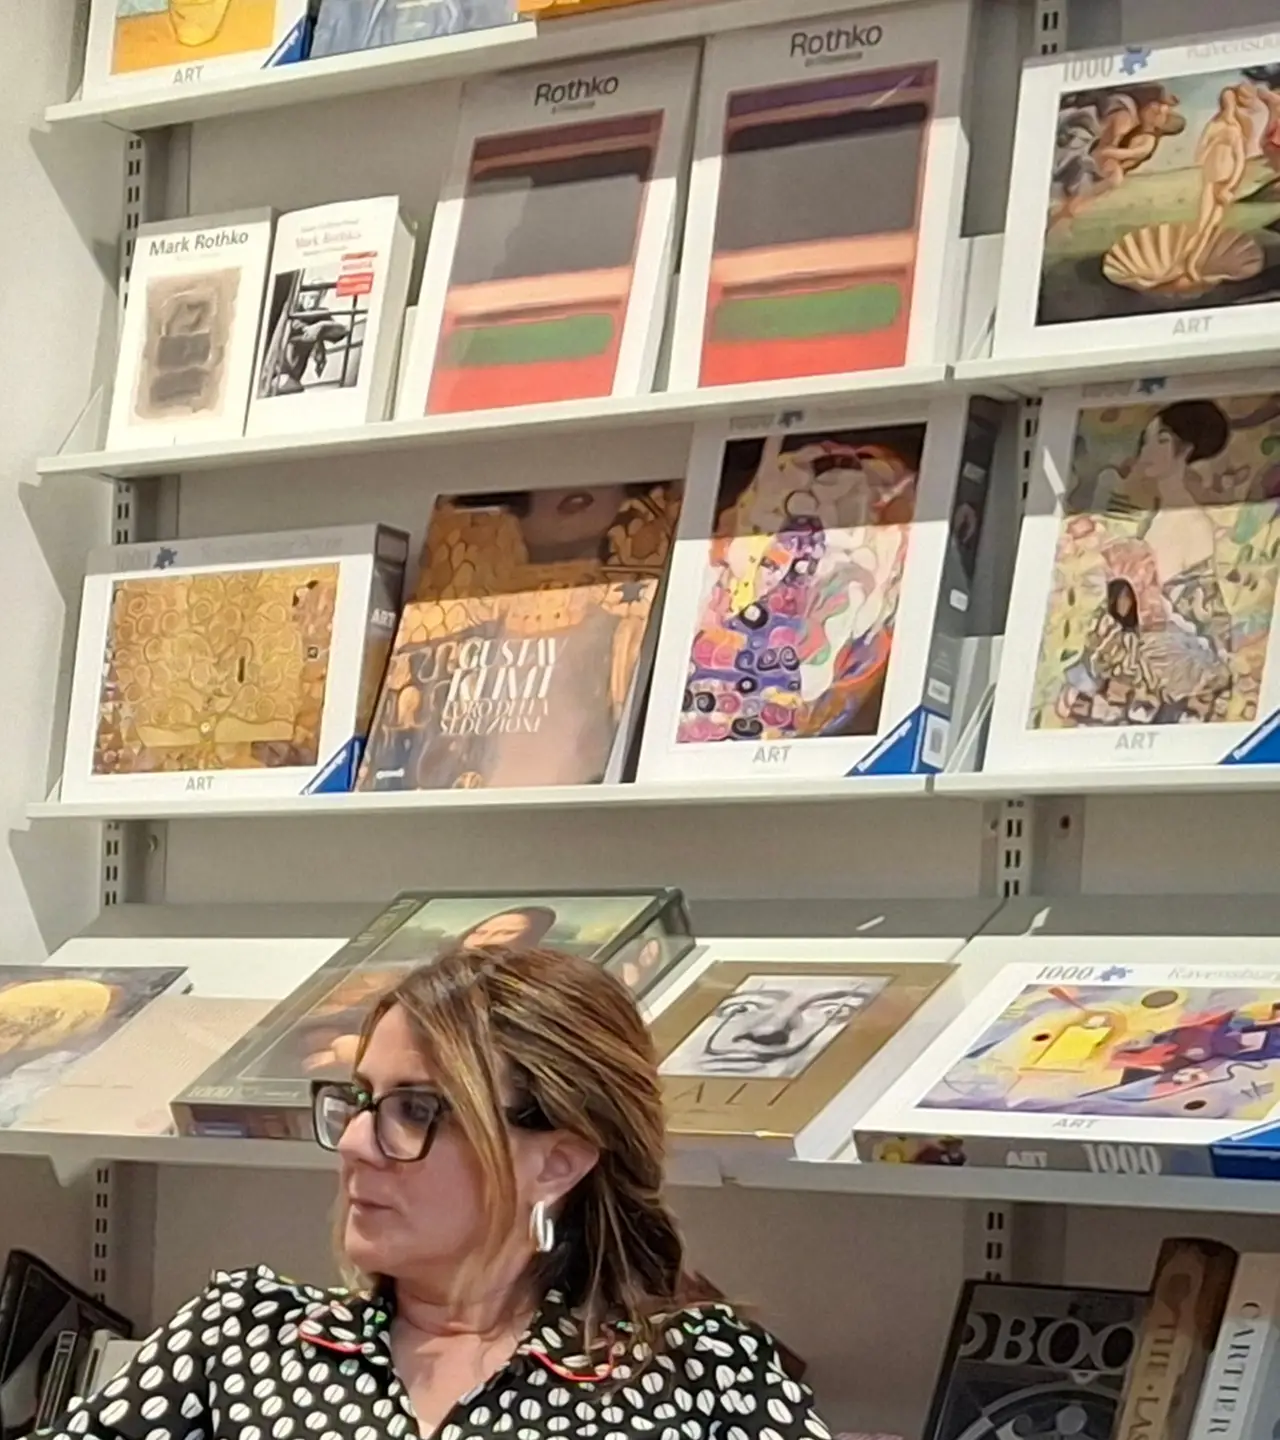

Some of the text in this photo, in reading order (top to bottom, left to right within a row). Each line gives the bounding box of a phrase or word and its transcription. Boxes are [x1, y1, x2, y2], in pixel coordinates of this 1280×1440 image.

[789, 24, 883, 59] Rothko
[171, 64, 204, 85] ART
[1062, 56, 1115, 83] 1000
[533, 74, 620, 107] Rothko
[149, 229, 249, 257] Mark Rothko
[1172, 314, 1215, 336] ART
[458, 636, 568, 669] GUSTAV
[446, 664, 554, 702] KLIMT
[751, 743, 793, 765] ART
[1113, 730, 1161, 751] ART
[184, 774, 215, 793] ART
[1035, 964, 1095, 981] 1000
[1051, 1118, 1100, 1130] ART
[1005, 1142, 1163, 1176] ART 1000
[1207, 1300, 1260, 1435] CARTIER
